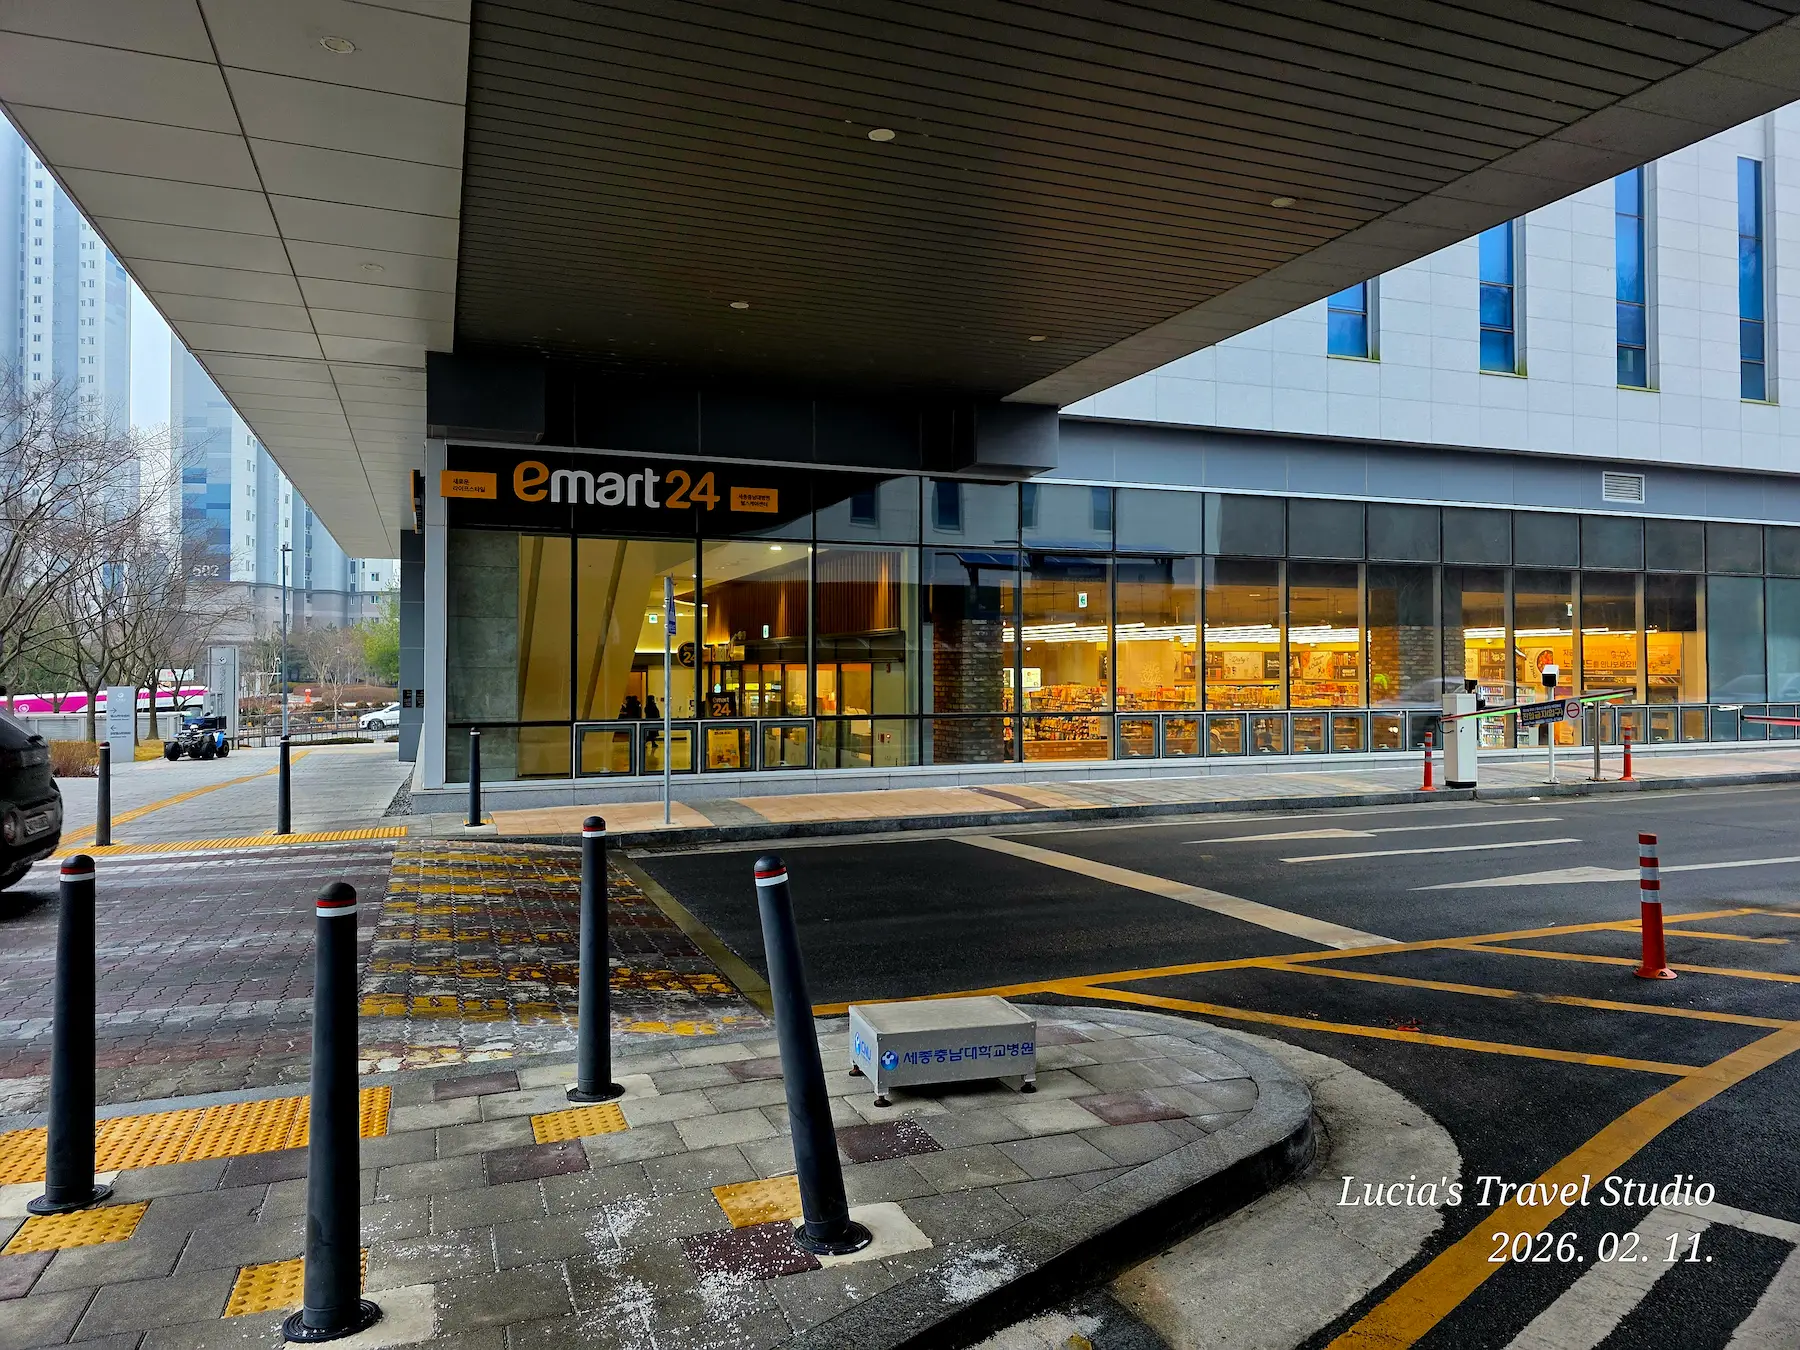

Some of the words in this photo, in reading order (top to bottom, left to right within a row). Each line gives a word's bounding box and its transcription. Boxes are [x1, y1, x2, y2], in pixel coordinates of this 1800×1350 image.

[453, 485, 486, 493] 라이프스타일
[712, 703, 731, 717] 24
[903, 1042, 1034, 1065] 세종충남대학교병원
